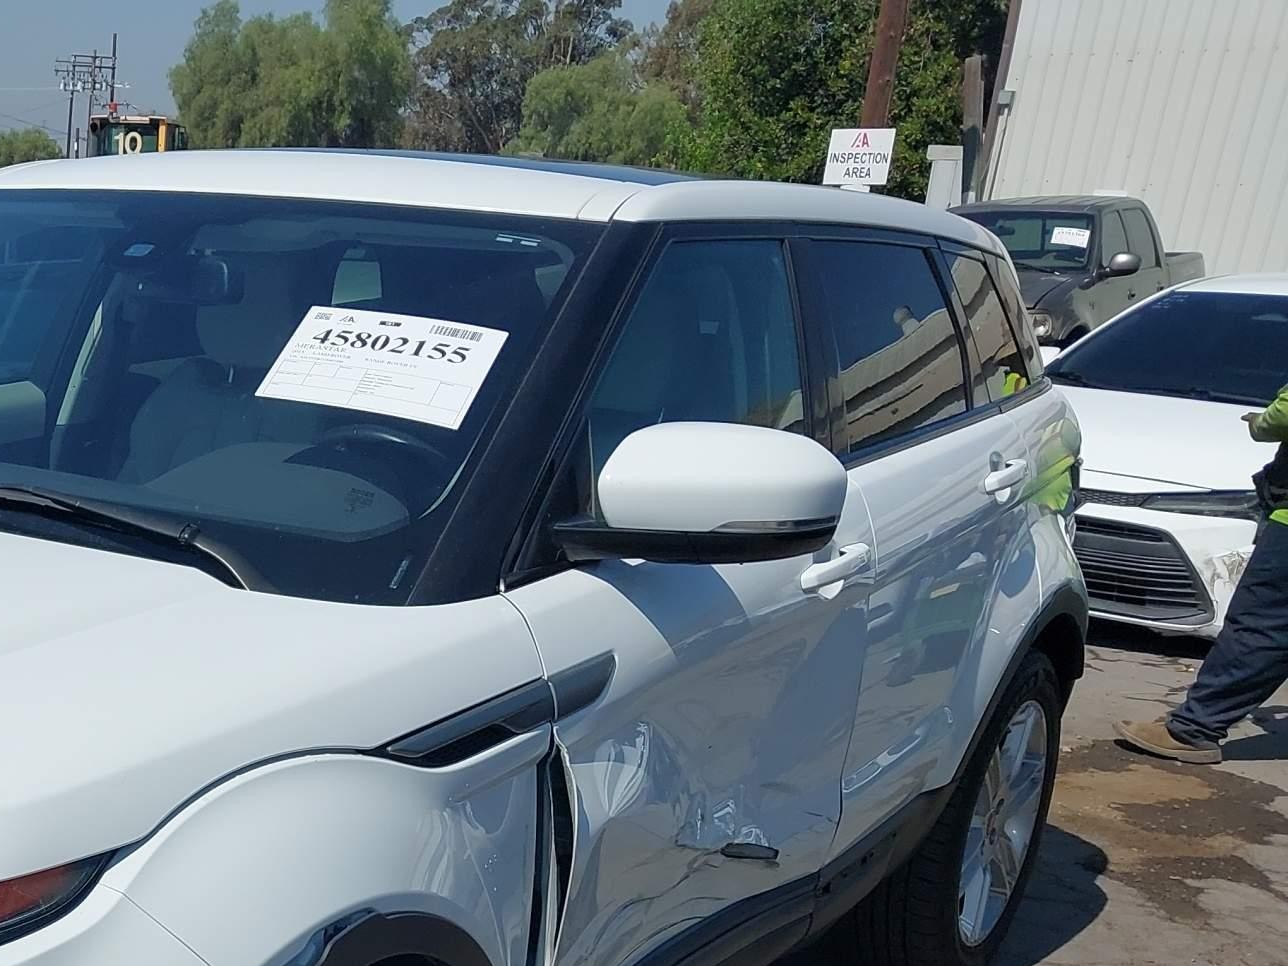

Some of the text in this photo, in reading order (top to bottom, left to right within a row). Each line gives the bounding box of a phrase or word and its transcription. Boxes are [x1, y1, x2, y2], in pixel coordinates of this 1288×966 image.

[114, 132, 142, 155] 10
[829, 152, 889, 164] INSPECTION
[843, 167, 871, 178] AREA
[312, 327, 472, 365] 45802155
